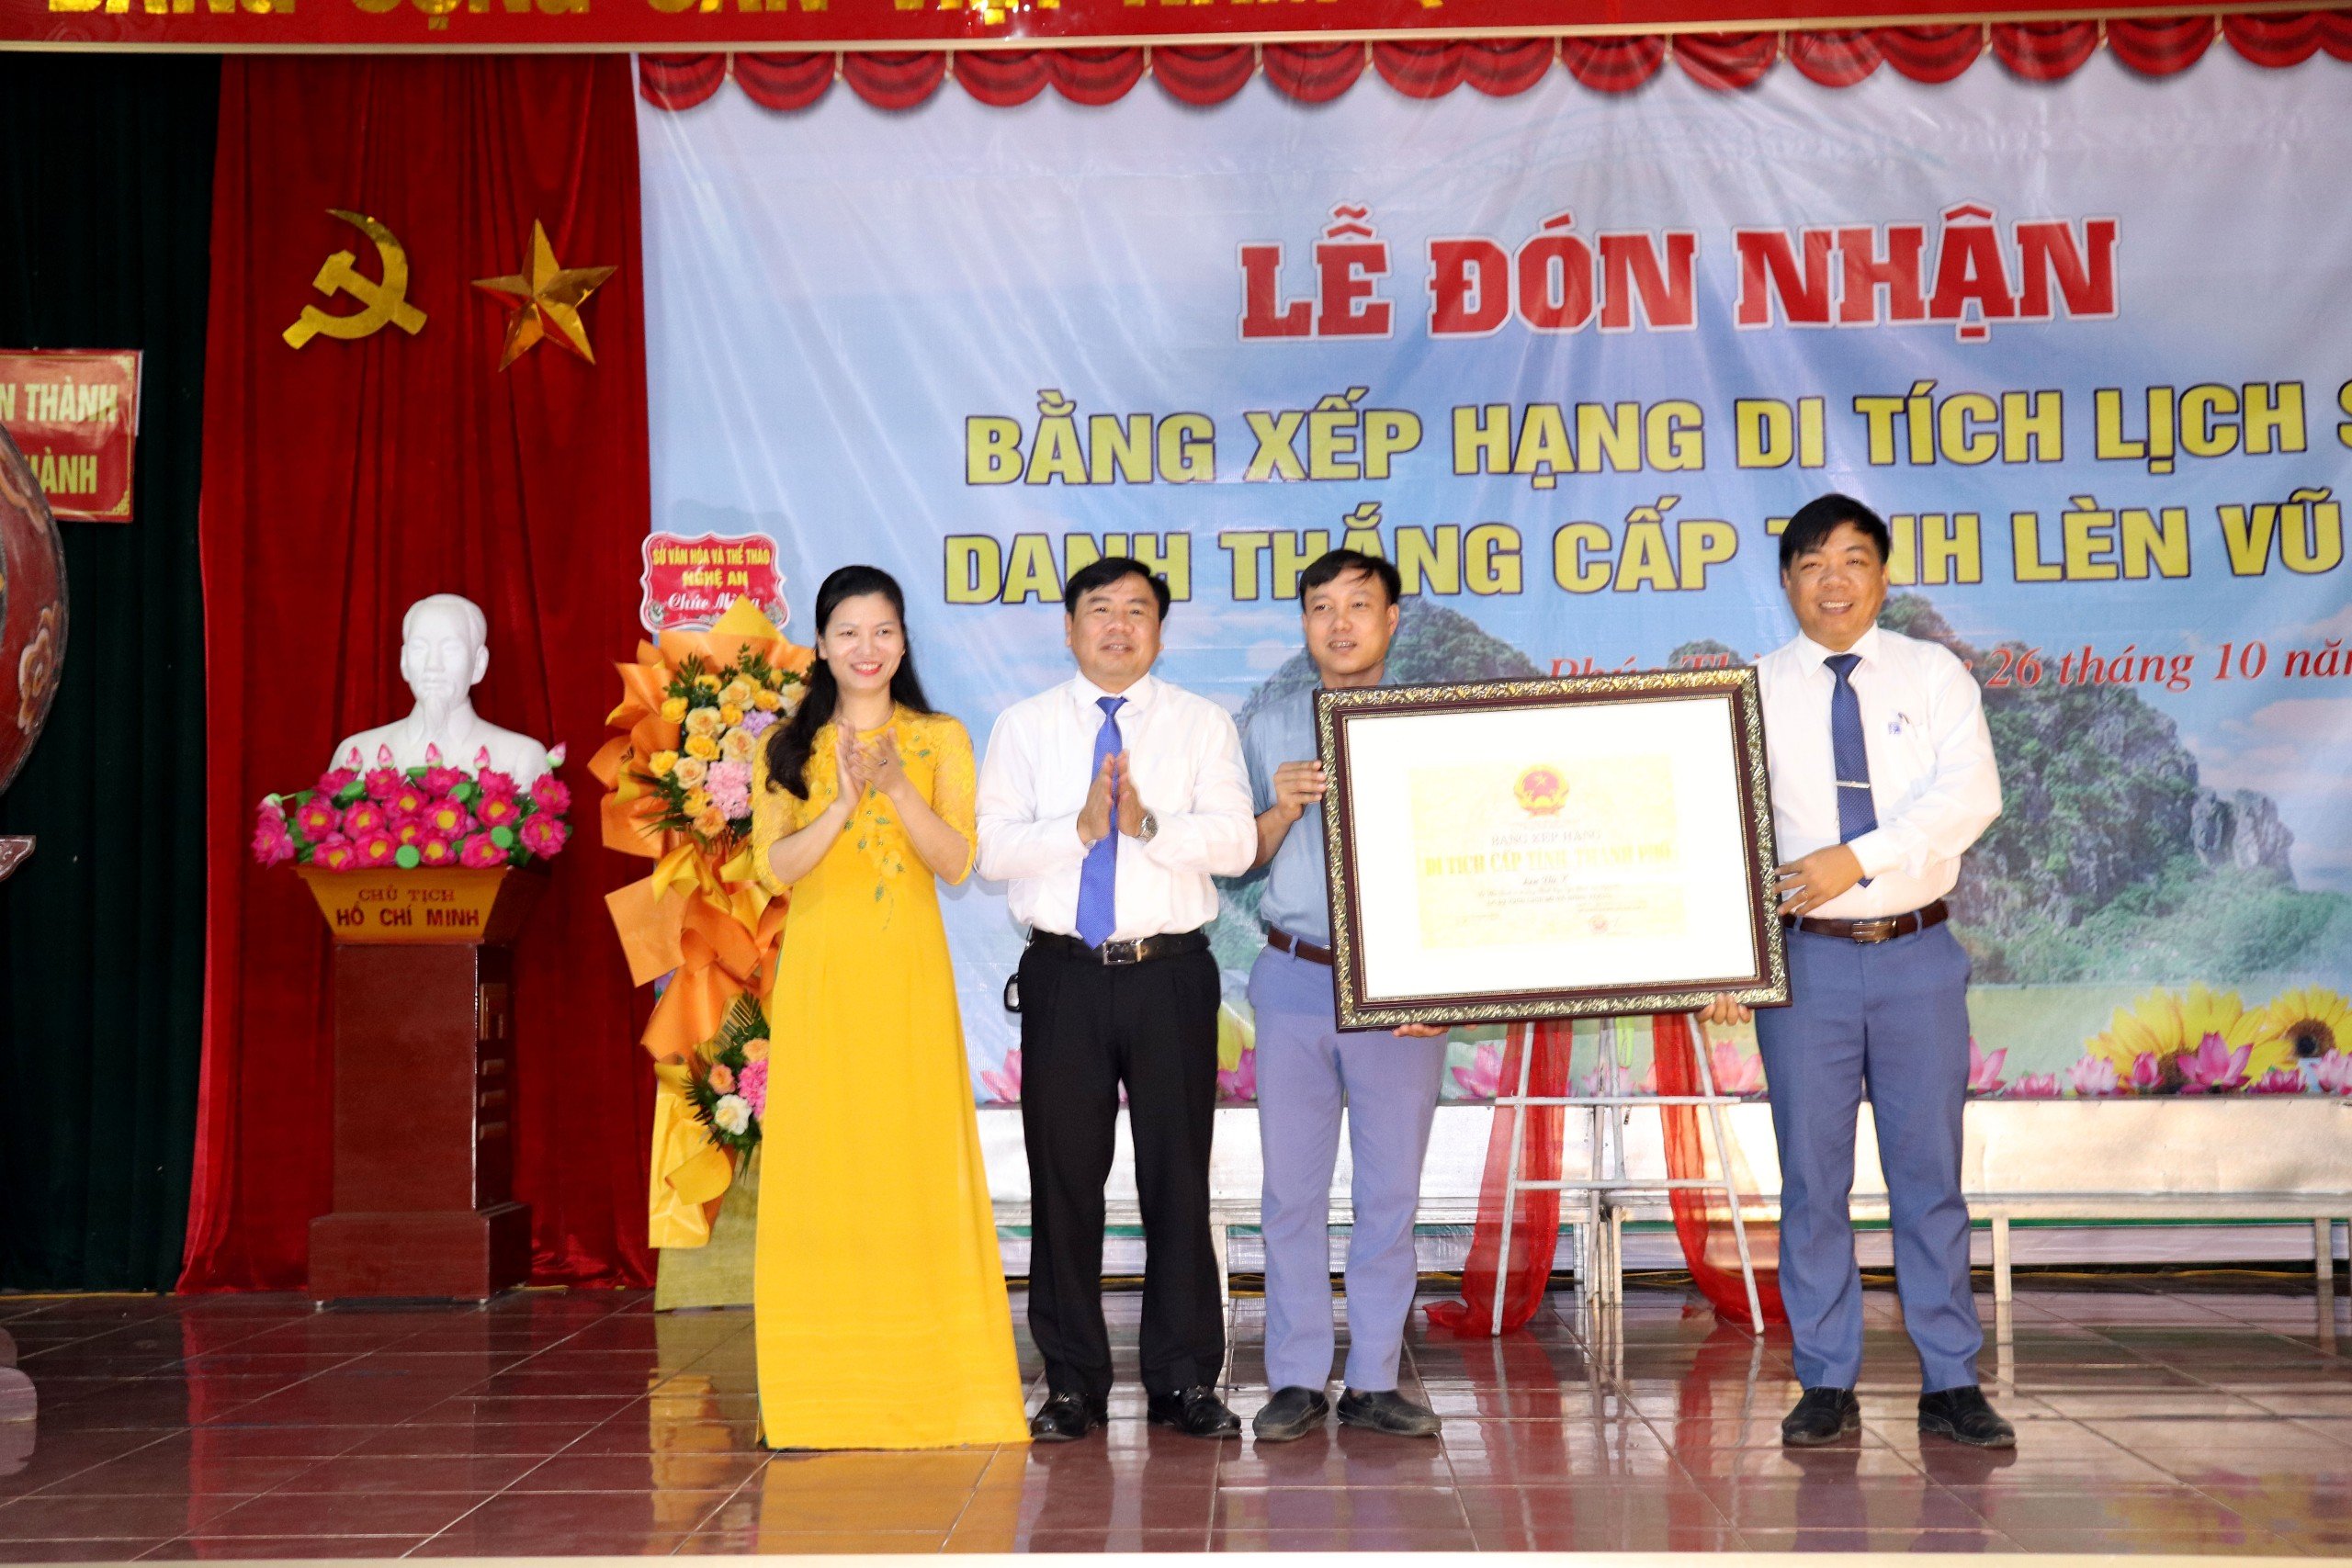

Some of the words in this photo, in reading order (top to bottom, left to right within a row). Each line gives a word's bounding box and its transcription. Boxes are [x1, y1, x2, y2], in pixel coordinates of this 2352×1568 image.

[1239, 202, 1392, 339] LỄ
[1428, 211, 1696, 334] ĐÓN
[1736, 203, 2118, 339] NHẬN
[25, 375, 119, 423] THÀNH
[965, 389, 1216, 485] BẰNG
[1243, 386, 1423, 482] XẾP
[1452, 398, 1704, 489] HẠNG
[1735, 396, 1826, 469] DI
[1853, 379, 2064, 466] TÍCH
[2094, 380, 2307, 475] LỊCH
[668, 546, 688, 565] VĂN
[711, 546, 725, 565] VÀ
[746, 547, 770, 565] THAO
[1554, 496, 1737, 592] CẤP
[2011, 494, 2191, 582] LÈN
[2216, 486, 2345, 576] VŨ
[682, 568, 723, 589] NGHỆ
[728, 570, 749, 587] AN
[668, 592, 709, 611] Chúc
[1984, 646, 2043, 688] 26
[2059, 645, 2195, 693] tháng
[2213, 640, 2268, 681] 10
[2284, 637, 2352, 679] nă
[358, 884, 398, 902] CHỦ
[408, 888, 456, 904] TỊCH
[336, 900, 365, 926] HỒ
[379, 905, 413, 926] CHÍ
[426, 908, 480, 926] MINH
